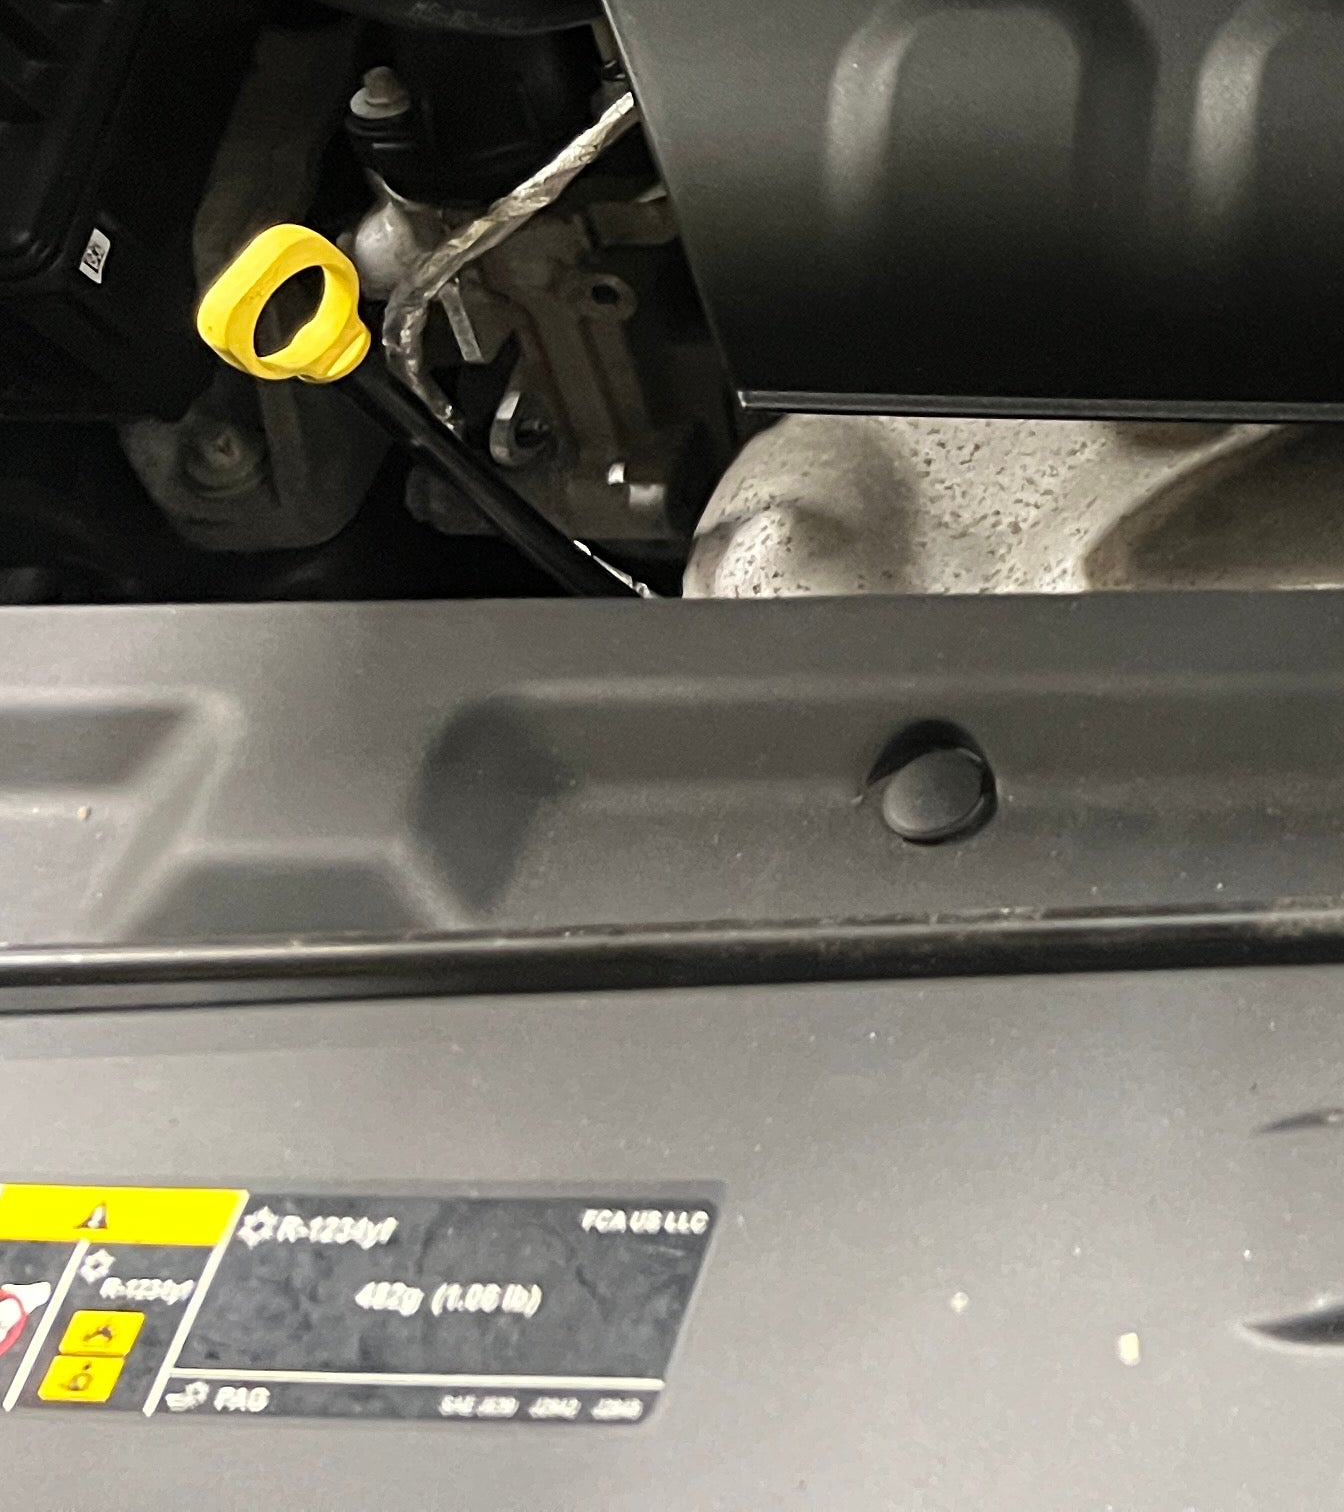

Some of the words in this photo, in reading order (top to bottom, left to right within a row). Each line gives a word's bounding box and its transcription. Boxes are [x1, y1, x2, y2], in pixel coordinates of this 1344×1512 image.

[581, 1207, 628, 1235] FCA
[628, 1208, 664, 1235] US
[663, 1208, 710, 1236] LLC
[213, 1385, 271, 1413] PAG
